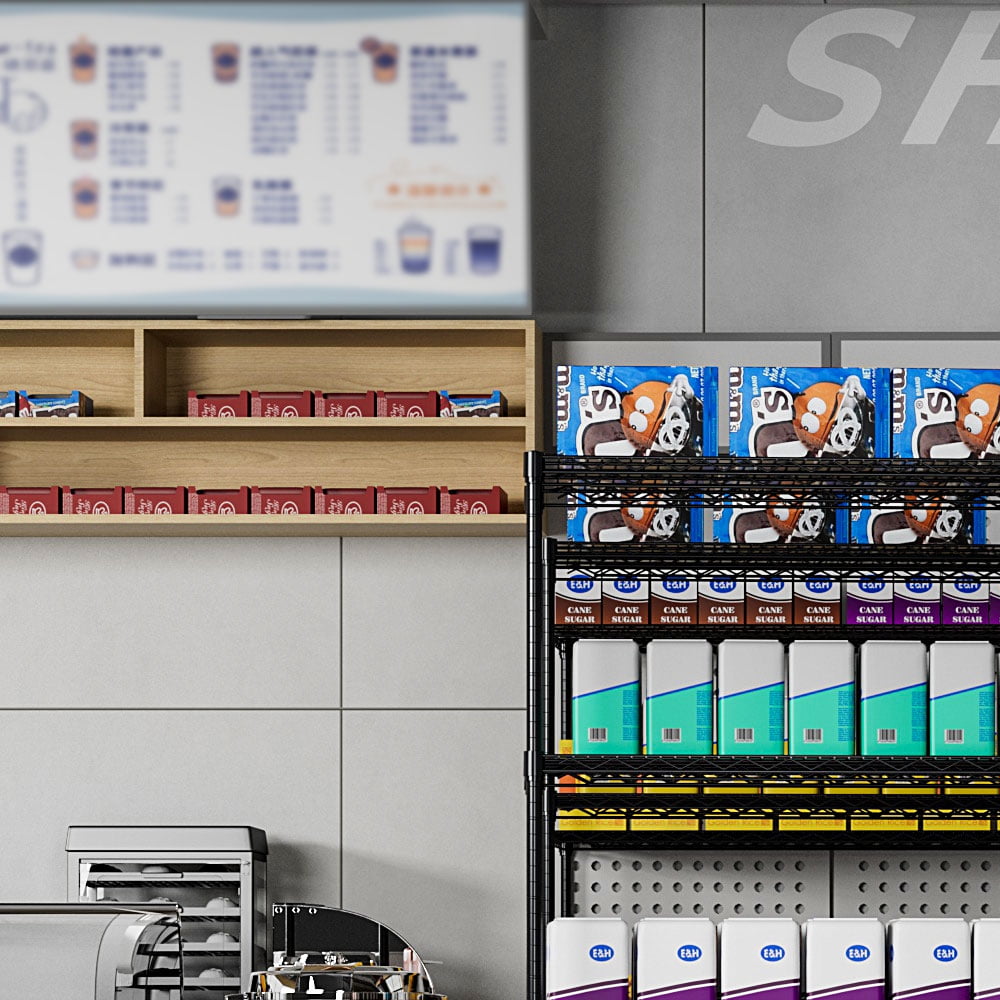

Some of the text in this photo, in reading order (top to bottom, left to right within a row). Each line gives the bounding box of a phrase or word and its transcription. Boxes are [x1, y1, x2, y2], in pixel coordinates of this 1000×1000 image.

[568, 606, 592, 614] CANE
[664, 606, 688, 614] CANE
[860, 606, 883, 614] CANE
[593, 948, 611, 958] E&H
[764, 948, 782, 958] E&H
[849, 949, 867, 958] E&H
[937, 949, 955, 958] E&H
